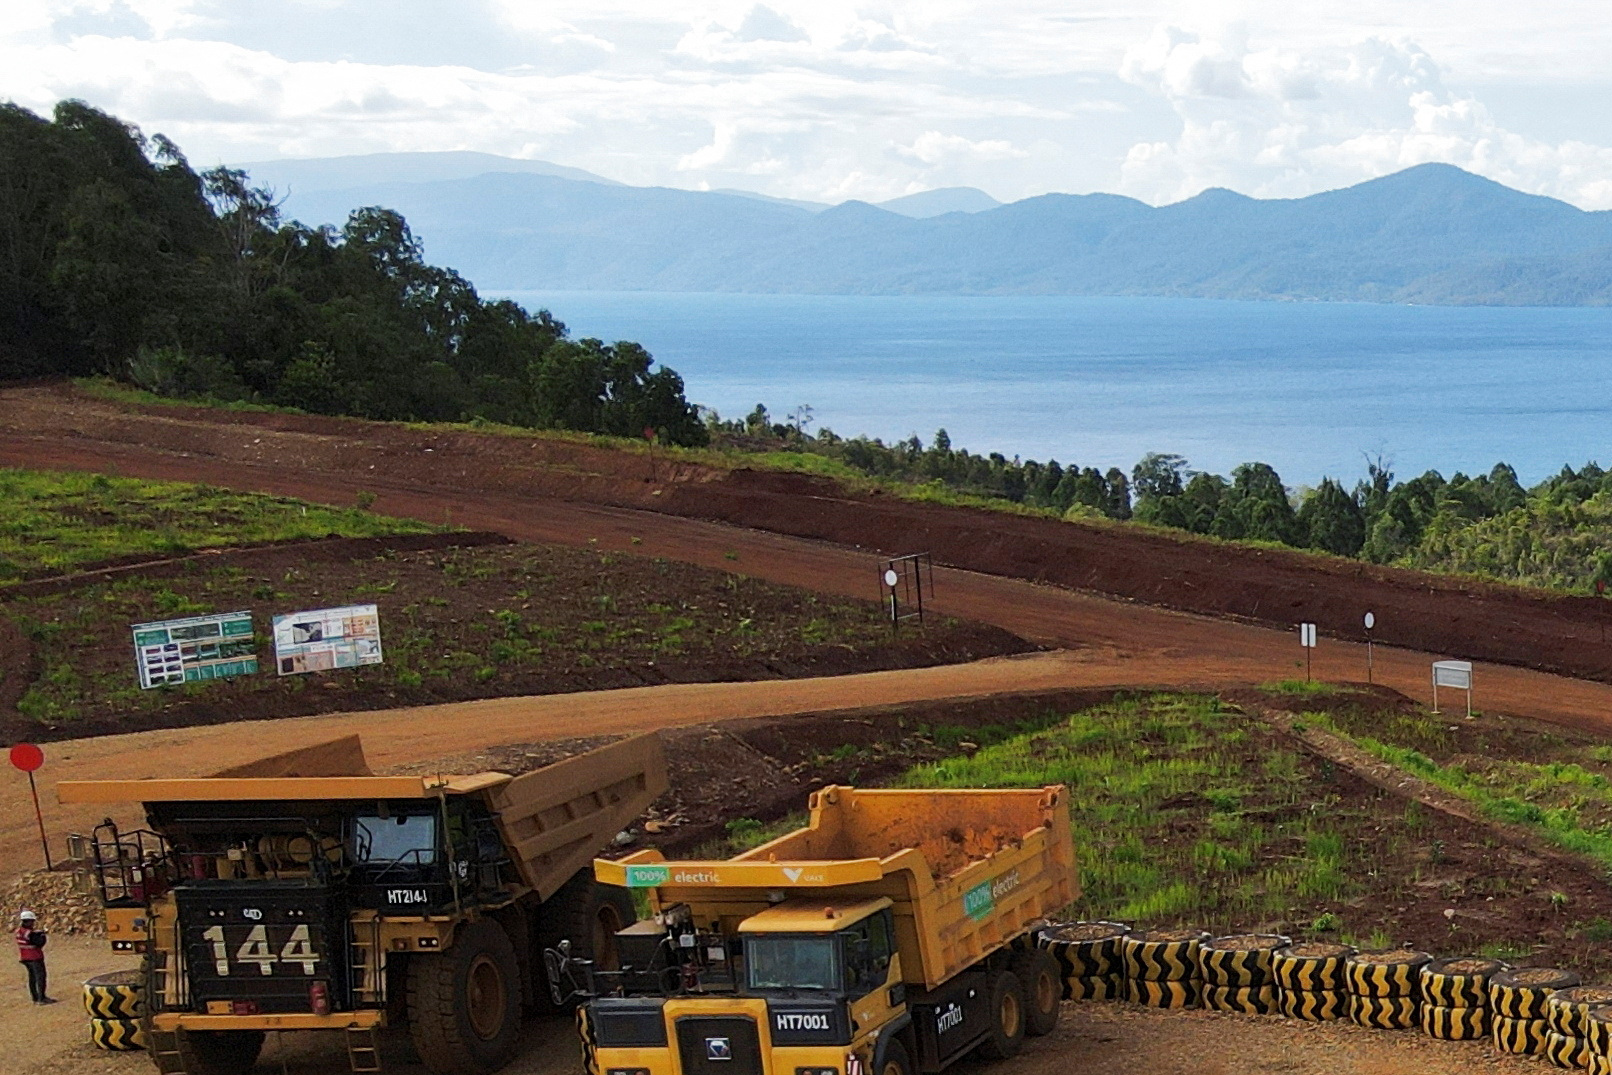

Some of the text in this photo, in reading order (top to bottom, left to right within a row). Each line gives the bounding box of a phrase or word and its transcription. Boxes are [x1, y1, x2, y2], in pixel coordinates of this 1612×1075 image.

[634, 870, 720, 883] 100% electric
[202, 924, 320, 977] 144
[776, 1014, 830, 1030] HT7001
